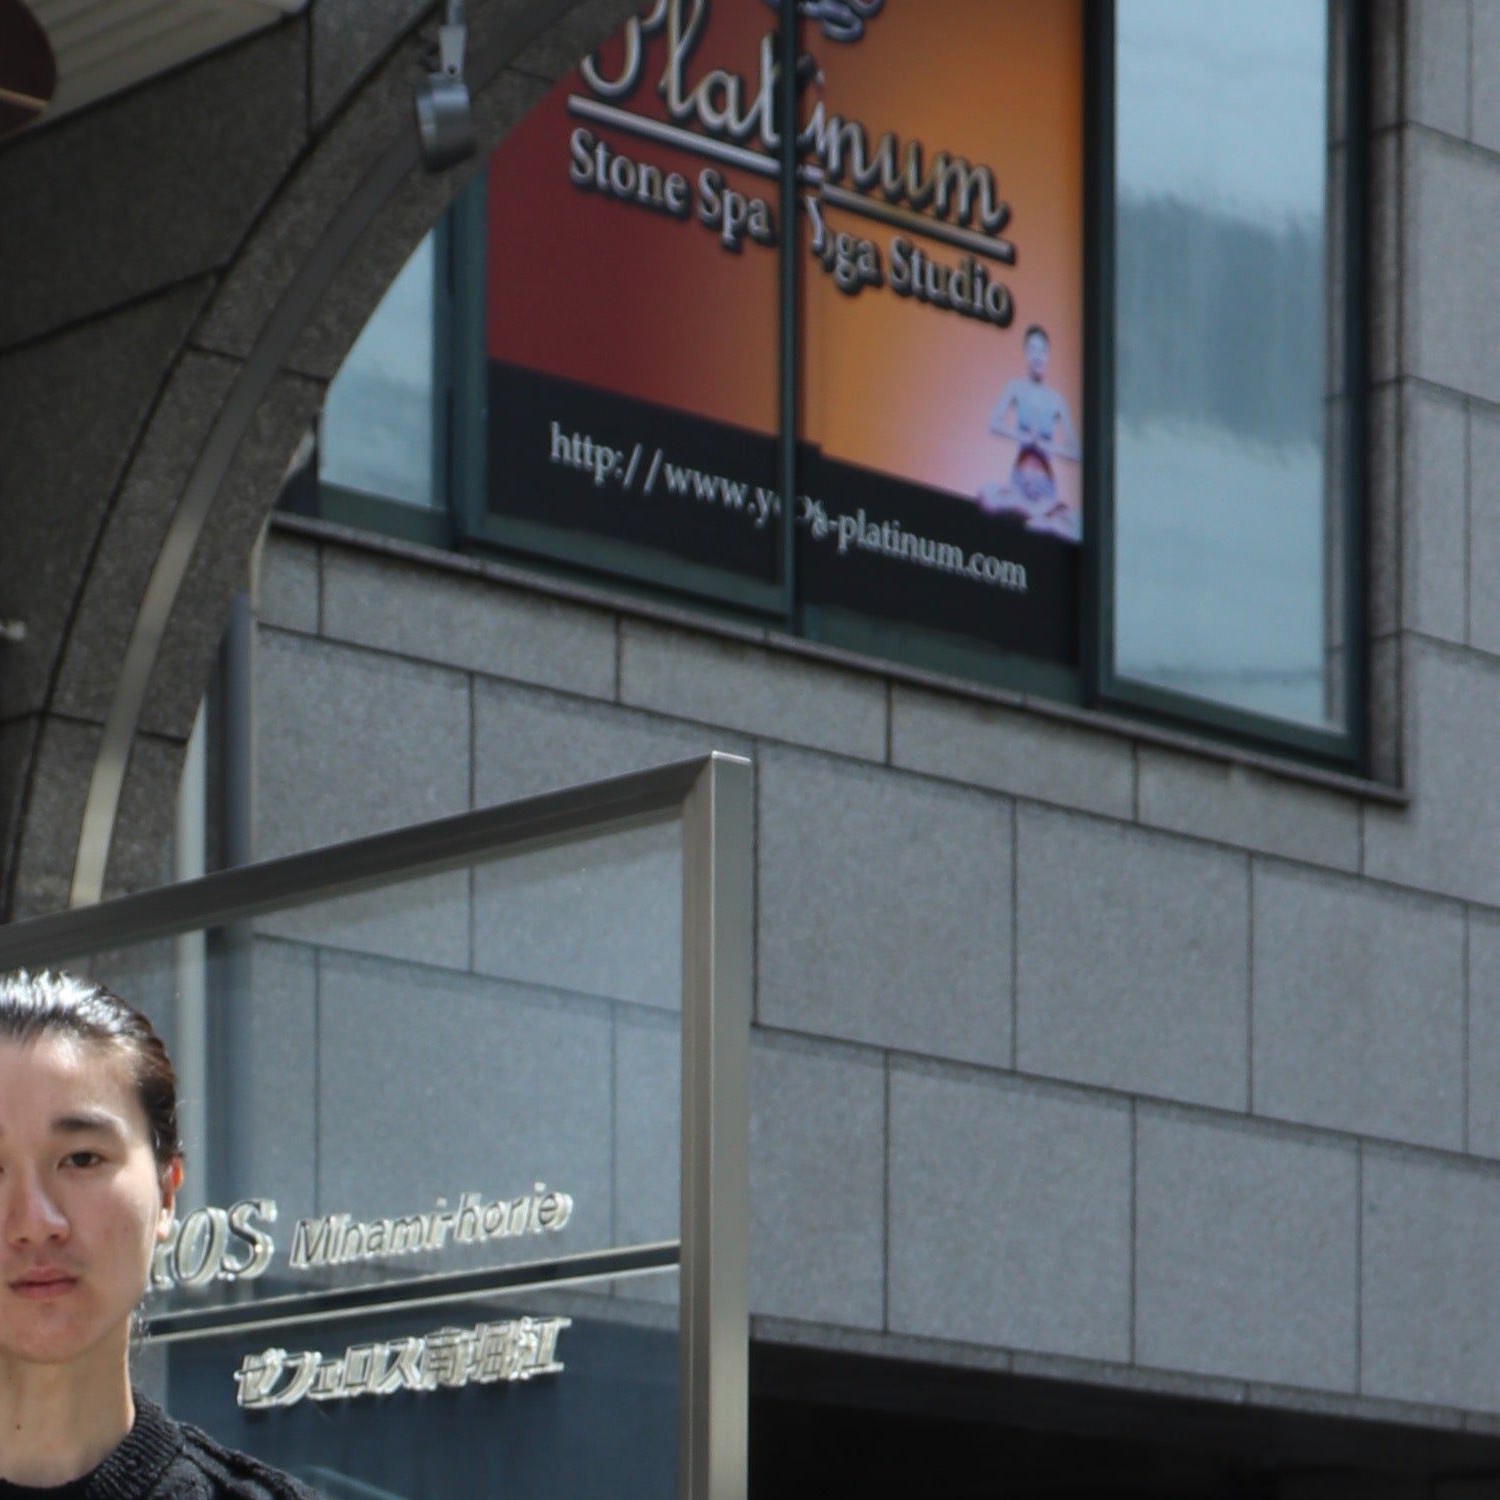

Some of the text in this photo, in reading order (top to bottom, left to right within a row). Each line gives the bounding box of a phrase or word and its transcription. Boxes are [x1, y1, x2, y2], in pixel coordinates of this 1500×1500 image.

[568, 126, 688, 212] Stone
[698, 168, 772, 249] Spa
[889, 237, 1012, 323] Studio
[288, 1181, 574, 1270] Minami-horie
